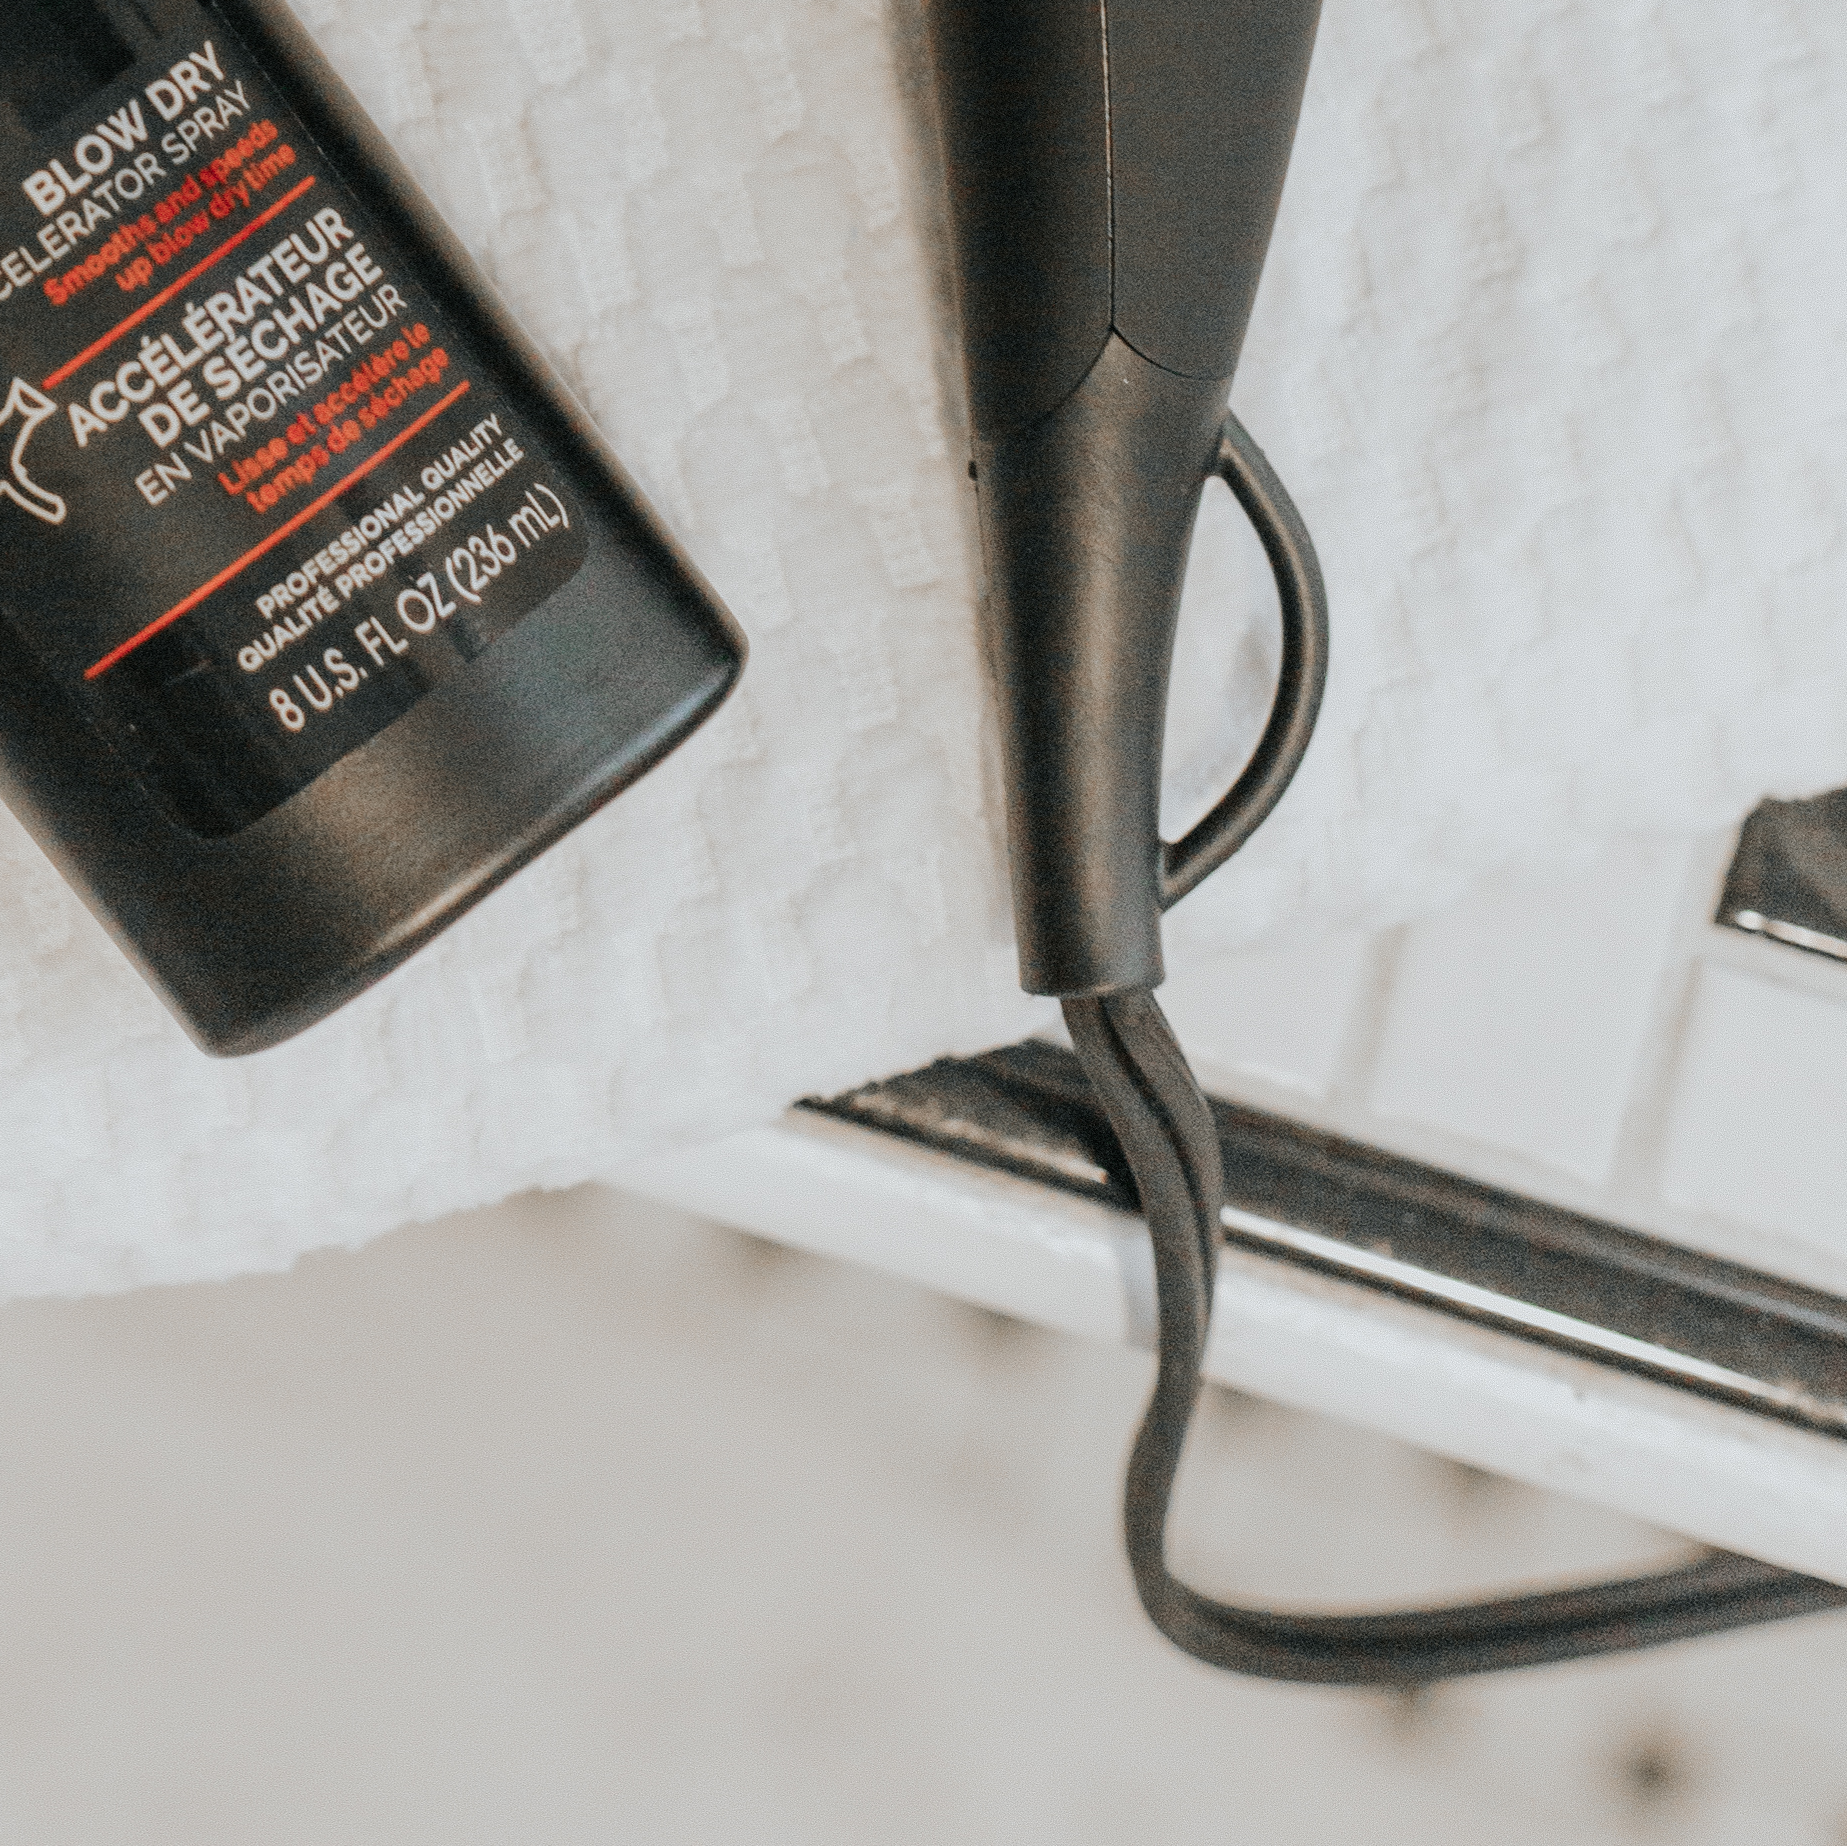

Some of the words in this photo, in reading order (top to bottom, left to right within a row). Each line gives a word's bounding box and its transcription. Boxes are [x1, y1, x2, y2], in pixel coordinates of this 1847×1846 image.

[19, 98, 154, 218] BLOW
[143, 39, 230, 123] DRY
[41, 211, 160, 307] Smooths
[150, 173, 205, 225] and
[195, 116, 282, 190] speeds
[113, 254, 157, 295] up
[144, 208, 213, 267] blow
[206, 177, 253, 223] dry
[240, 141, 298, 192] time
[158, 78, 255, 166] SPRAY
[47, 203, 363, 449] ACCÉLÉRATEUR
[133, 450, 194, 508] EN
[173, 281, 411, 467] VAPORISATEUR
[136, 378, 212, 449] DE
[190, 241, 386, 402] SÉCHAGE
[233, 582, 342, 674] QUALITÉ
[323, 436, 528, 600] PROFESSIONNELLE
[244, 441, 334, 517] temps
[322, 415, 364, 456] de
[253, 482, 428, 620] PROFESSIONAL
[416, 411, 507, 493] QUALITY
[266, 685, 309, 734] 8
[291, 643, 370, 714] U.S.
[352, 611, 411, 668] FL
[392, 570, 459, 637] OZ
[440, 521, 523, 608] (236
[503, 479, 573, 552] mL)
